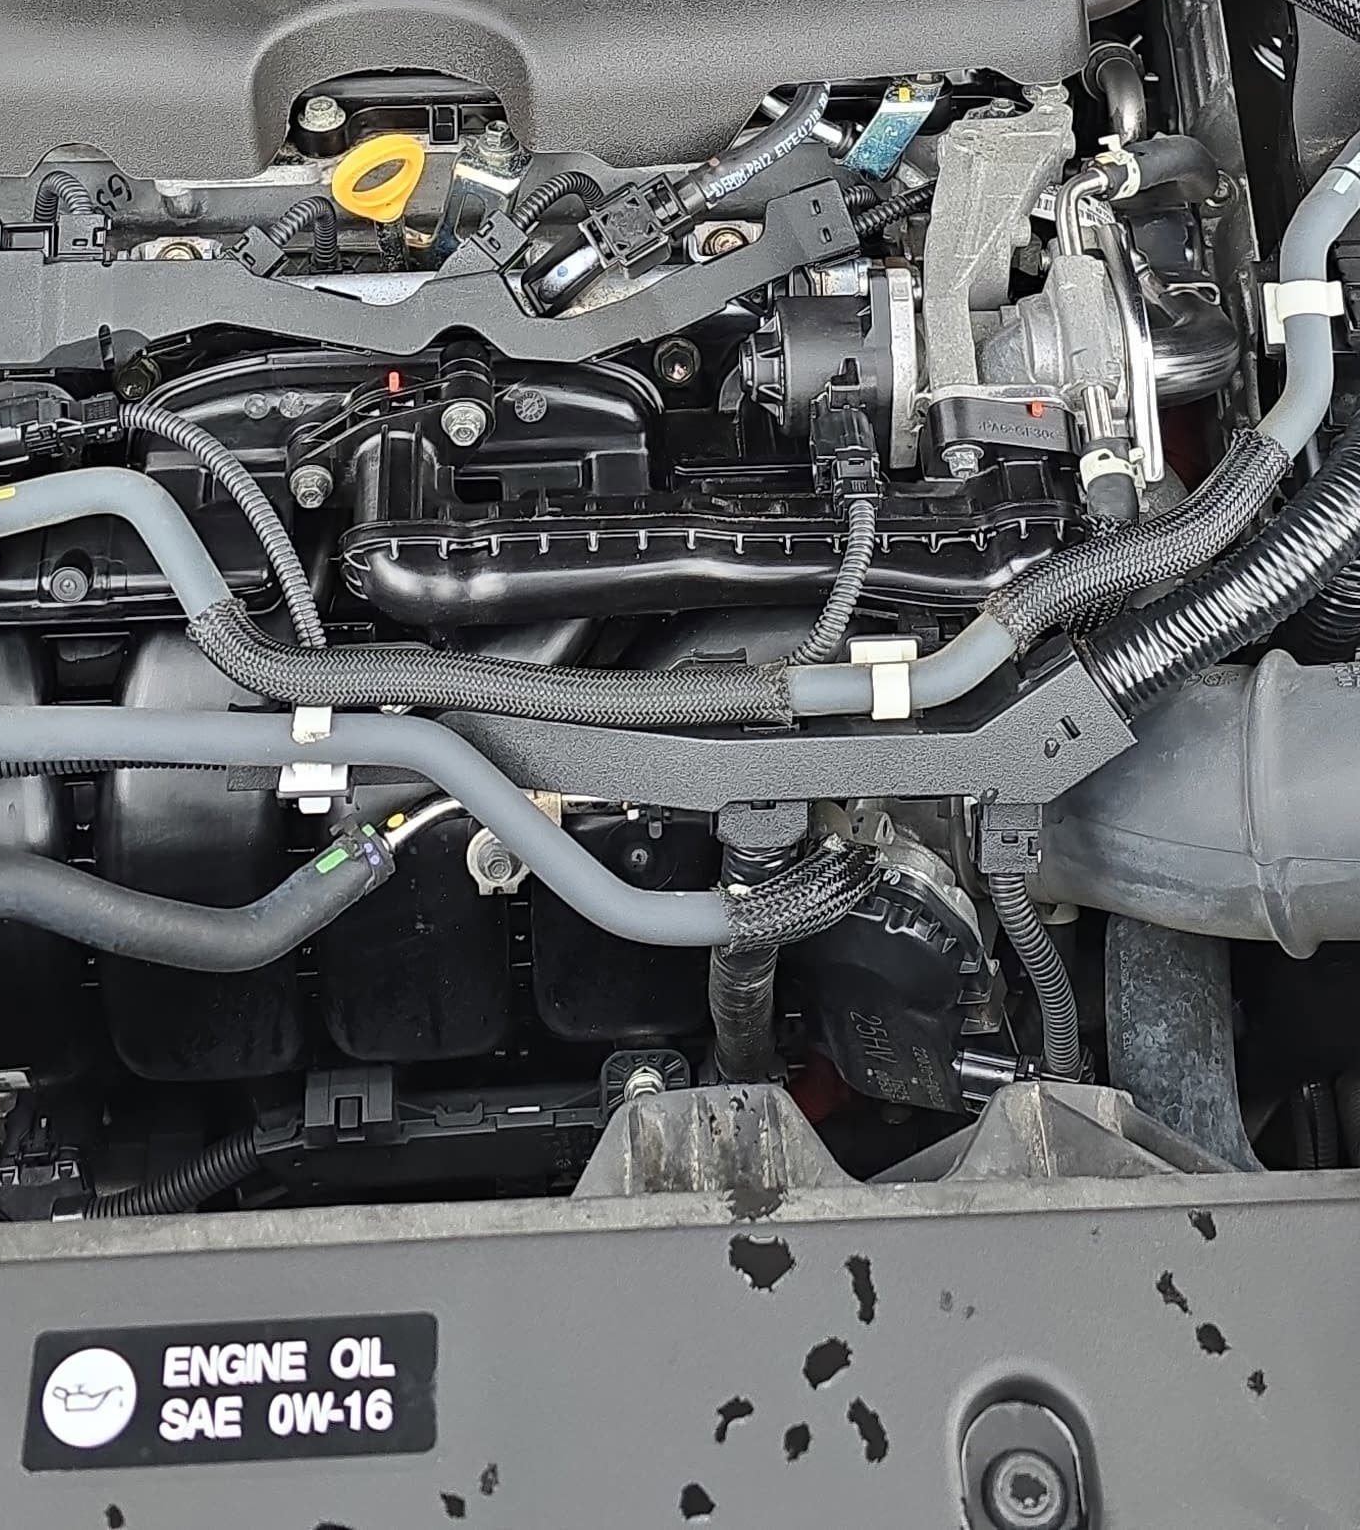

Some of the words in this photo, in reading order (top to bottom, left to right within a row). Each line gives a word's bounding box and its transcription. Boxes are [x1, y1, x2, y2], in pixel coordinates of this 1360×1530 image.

[849, 1011, 899, 1064] 25HV
[162, 1340, 309, 1388] ENGINE
[329, 1337, 397, 1380] OIL
[158, 1394, 243, 1442] SAE
[268, 1388, 394, 1436] 0W-16
